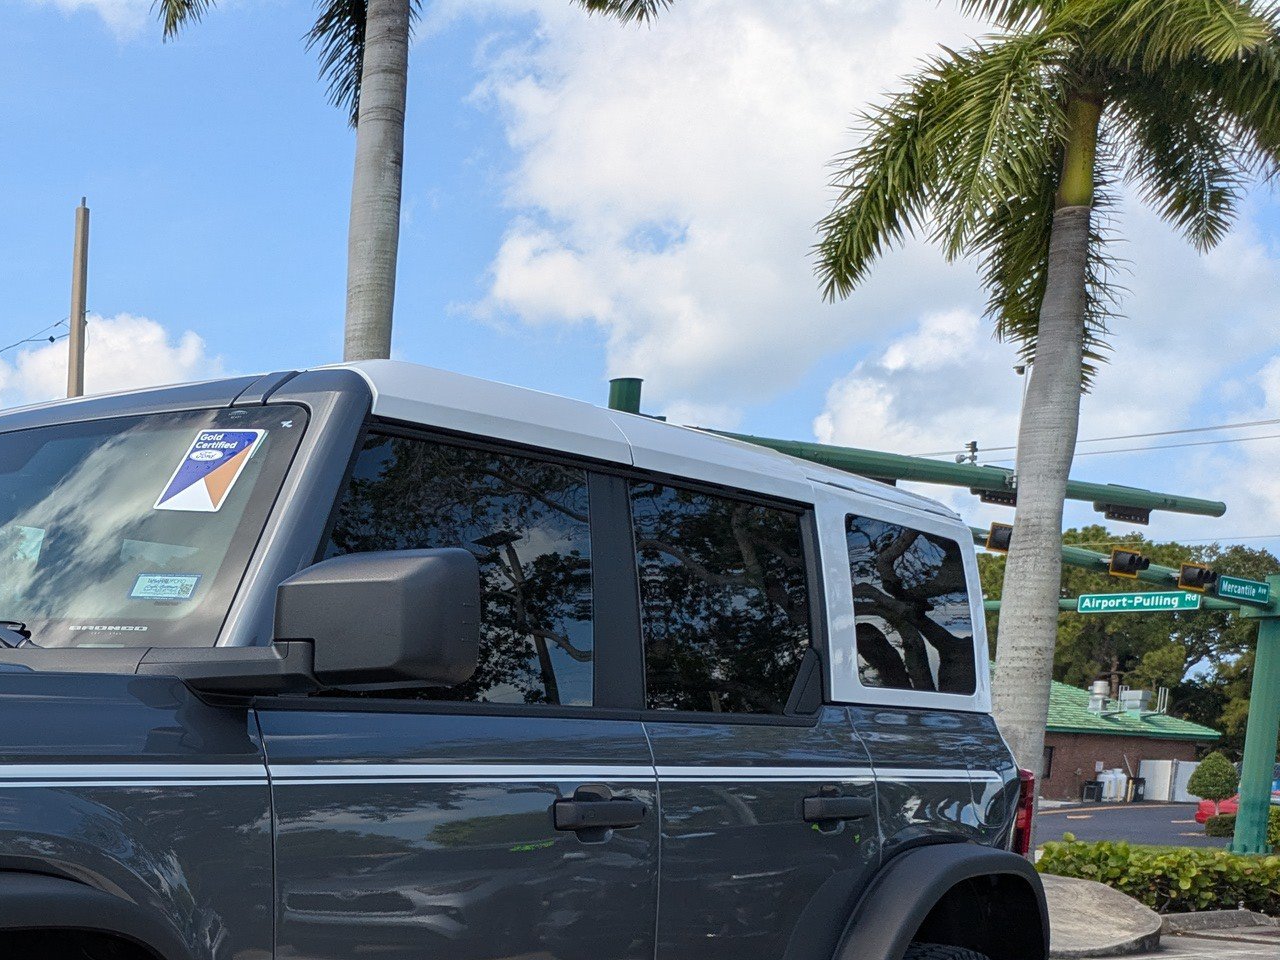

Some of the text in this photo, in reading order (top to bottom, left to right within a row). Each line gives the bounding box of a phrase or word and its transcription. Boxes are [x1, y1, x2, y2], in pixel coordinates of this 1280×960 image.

[200, 433, 224, 441] Gold
[195, 441, 238, 449] Certified
[1222, 580, 1267, 597] Mercantile Ave
[1082, 593, 1197, 610] Airport-Pulling Rd
